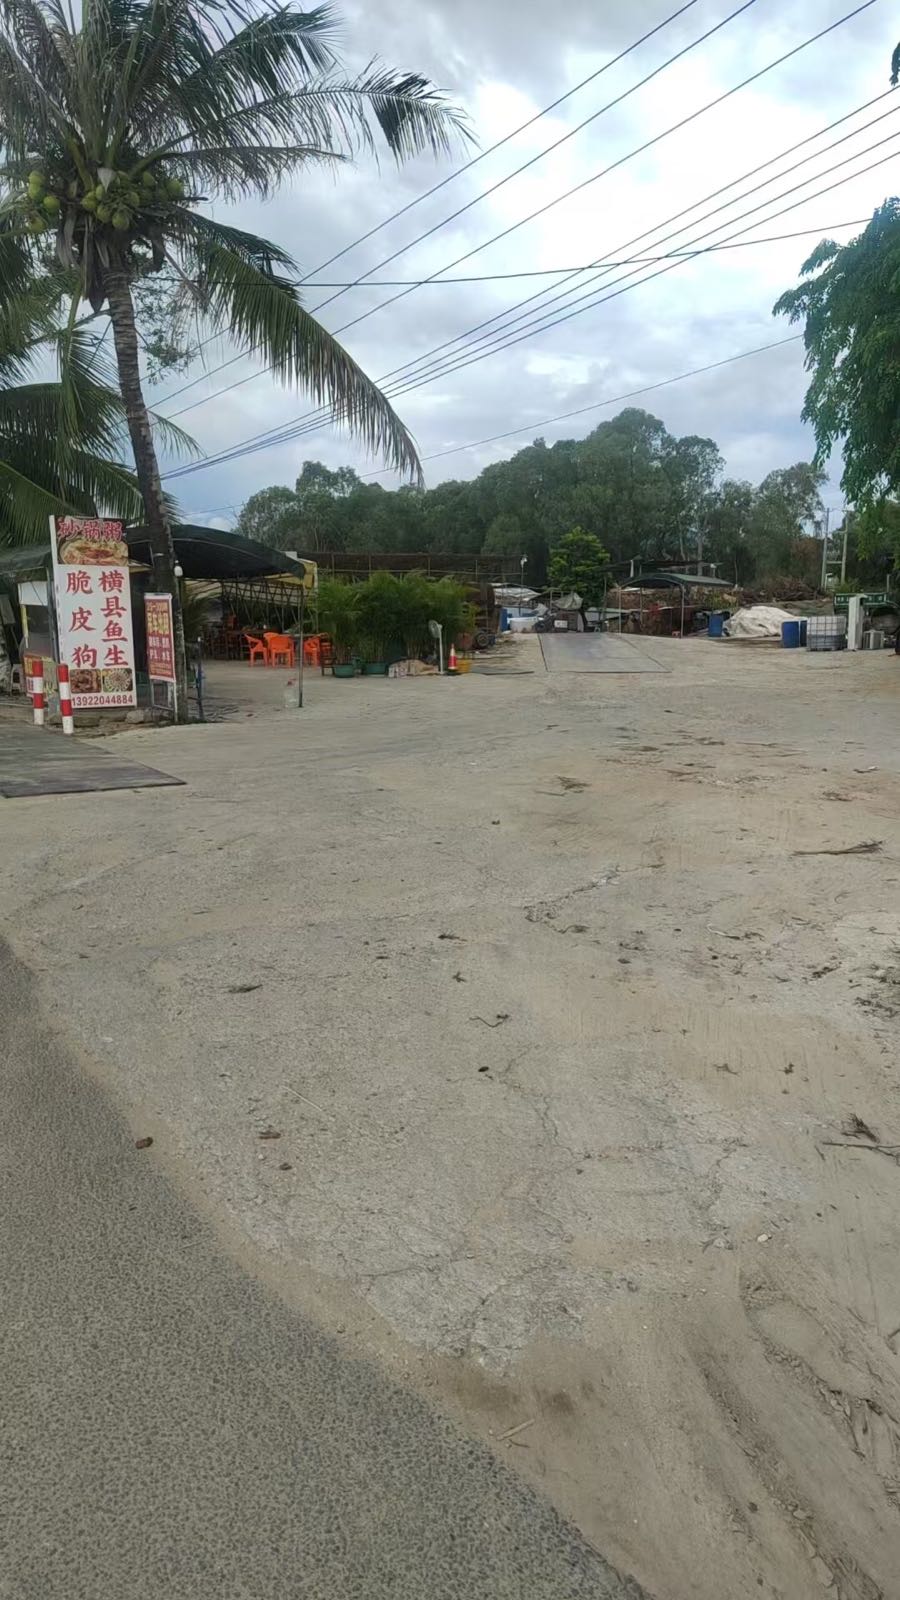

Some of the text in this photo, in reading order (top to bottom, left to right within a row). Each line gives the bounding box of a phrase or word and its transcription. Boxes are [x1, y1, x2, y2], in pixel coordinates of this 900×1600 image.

[58, 517, 122, 542] 砂锅粥
[66, 570, 98, 669] 脆皮狗
[98, 570, 129, 667] 横县鱼生
[72, 695, 133, 707] 13922044884
